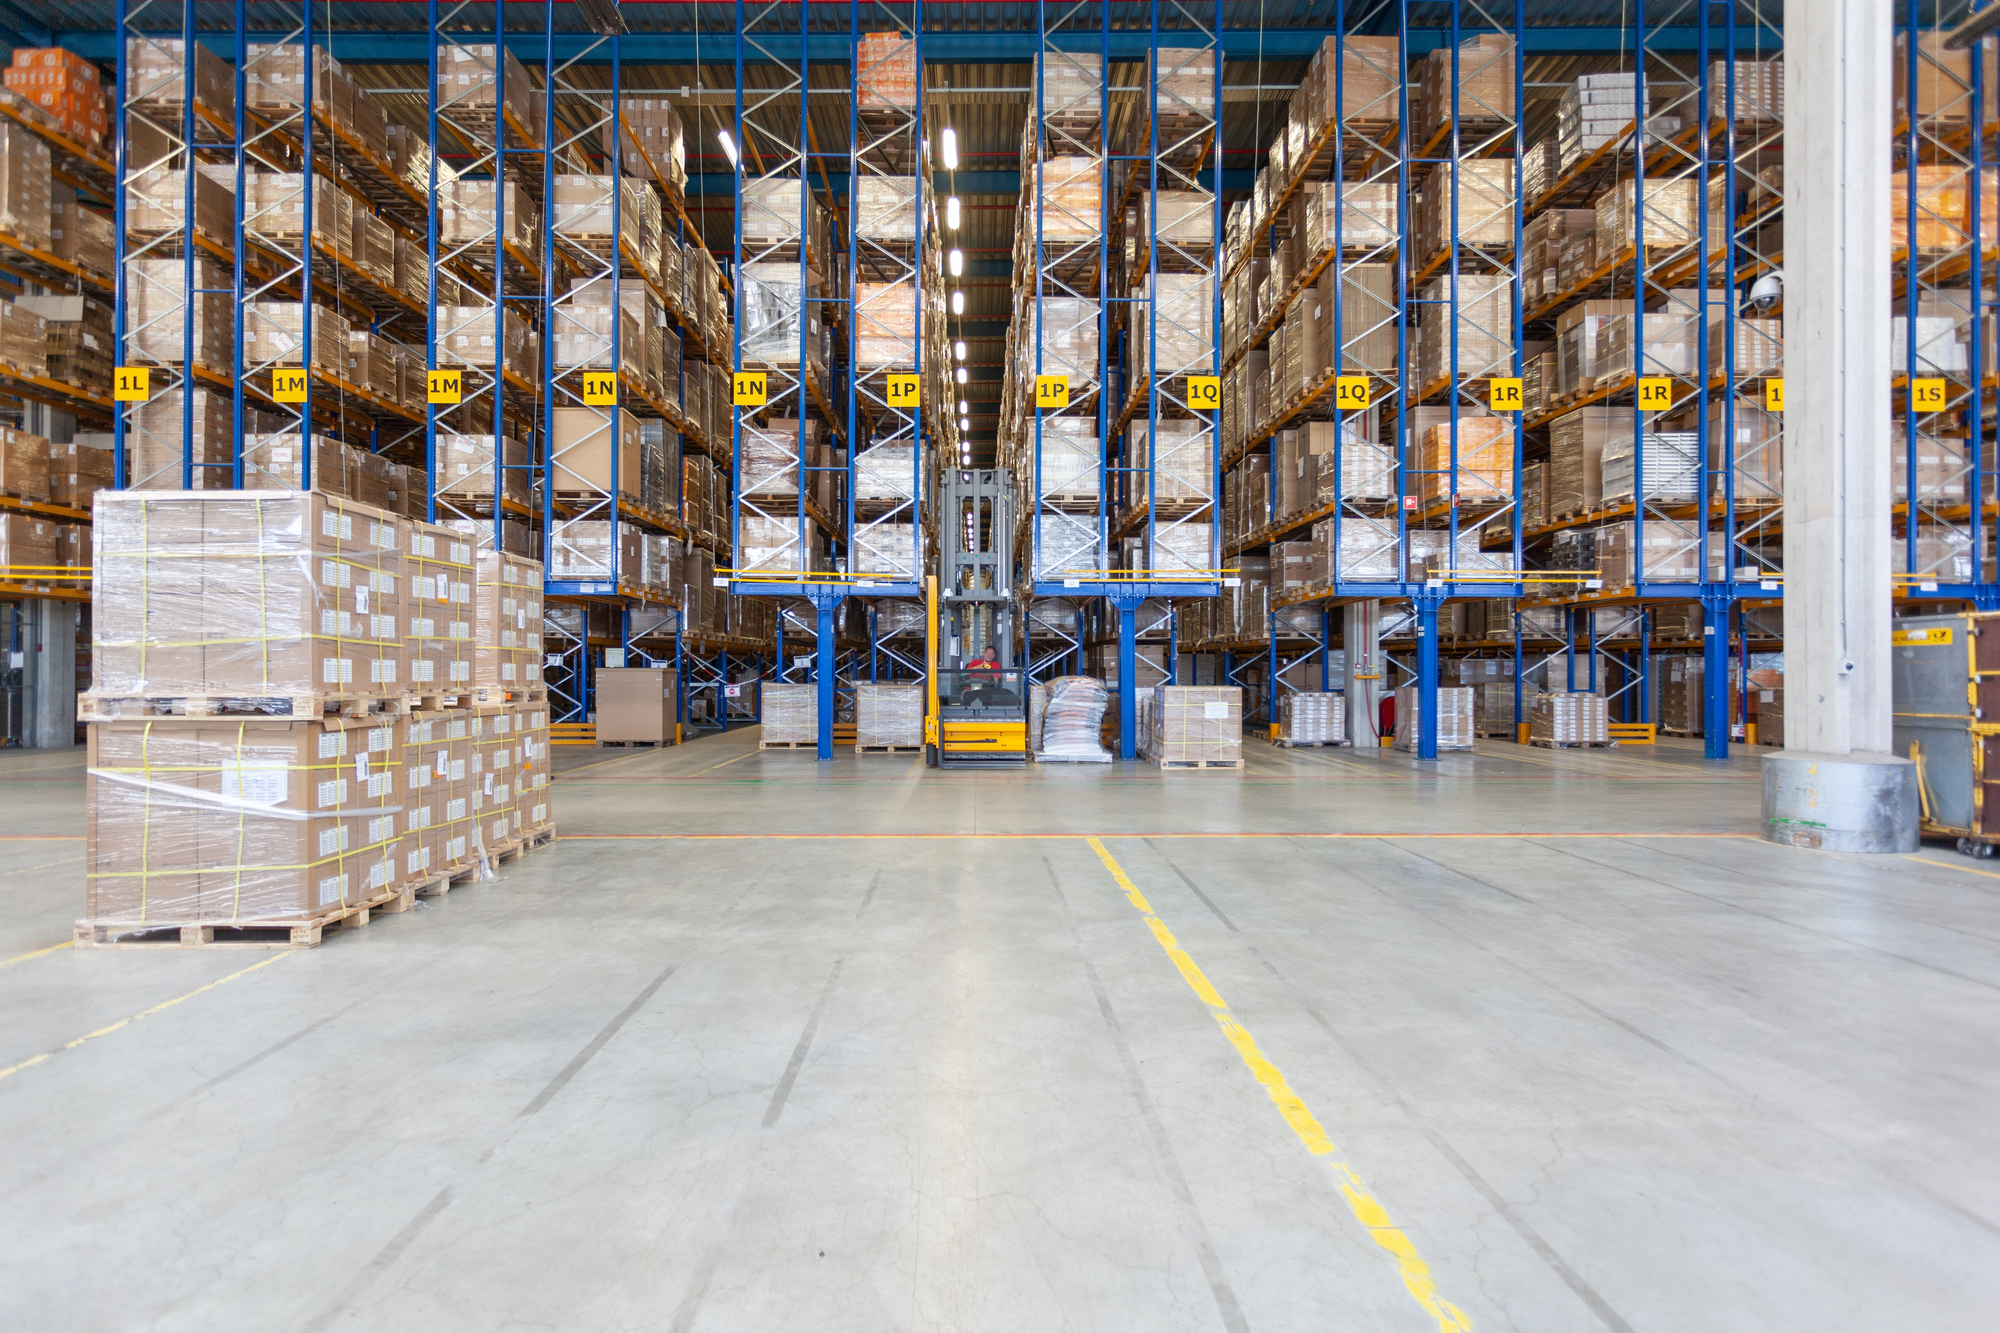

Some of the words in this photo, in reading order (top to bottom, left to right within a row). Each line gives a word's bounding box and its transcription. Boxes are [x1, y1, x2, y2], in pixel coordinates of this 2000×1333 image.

[120, 376, 144, 390] 1L
[275, 377, 305, 392] 1M
[430, 378, 459, 393] 1M
[587, 380, 613, 395] 1N
[737, 380, 763, 395] 1N
[891, 382, 916, 397] 1P
[1040, 383, 1065, 398] 1P
[1191, 384, 1217, 403] 1Q
[1339, 384, 1366, 403] 1Q
[1495, 386, 1520, 401] 1R
[1642, 385, 1668, 400] 1R
[1919, 387, 1942, 402] 1S
